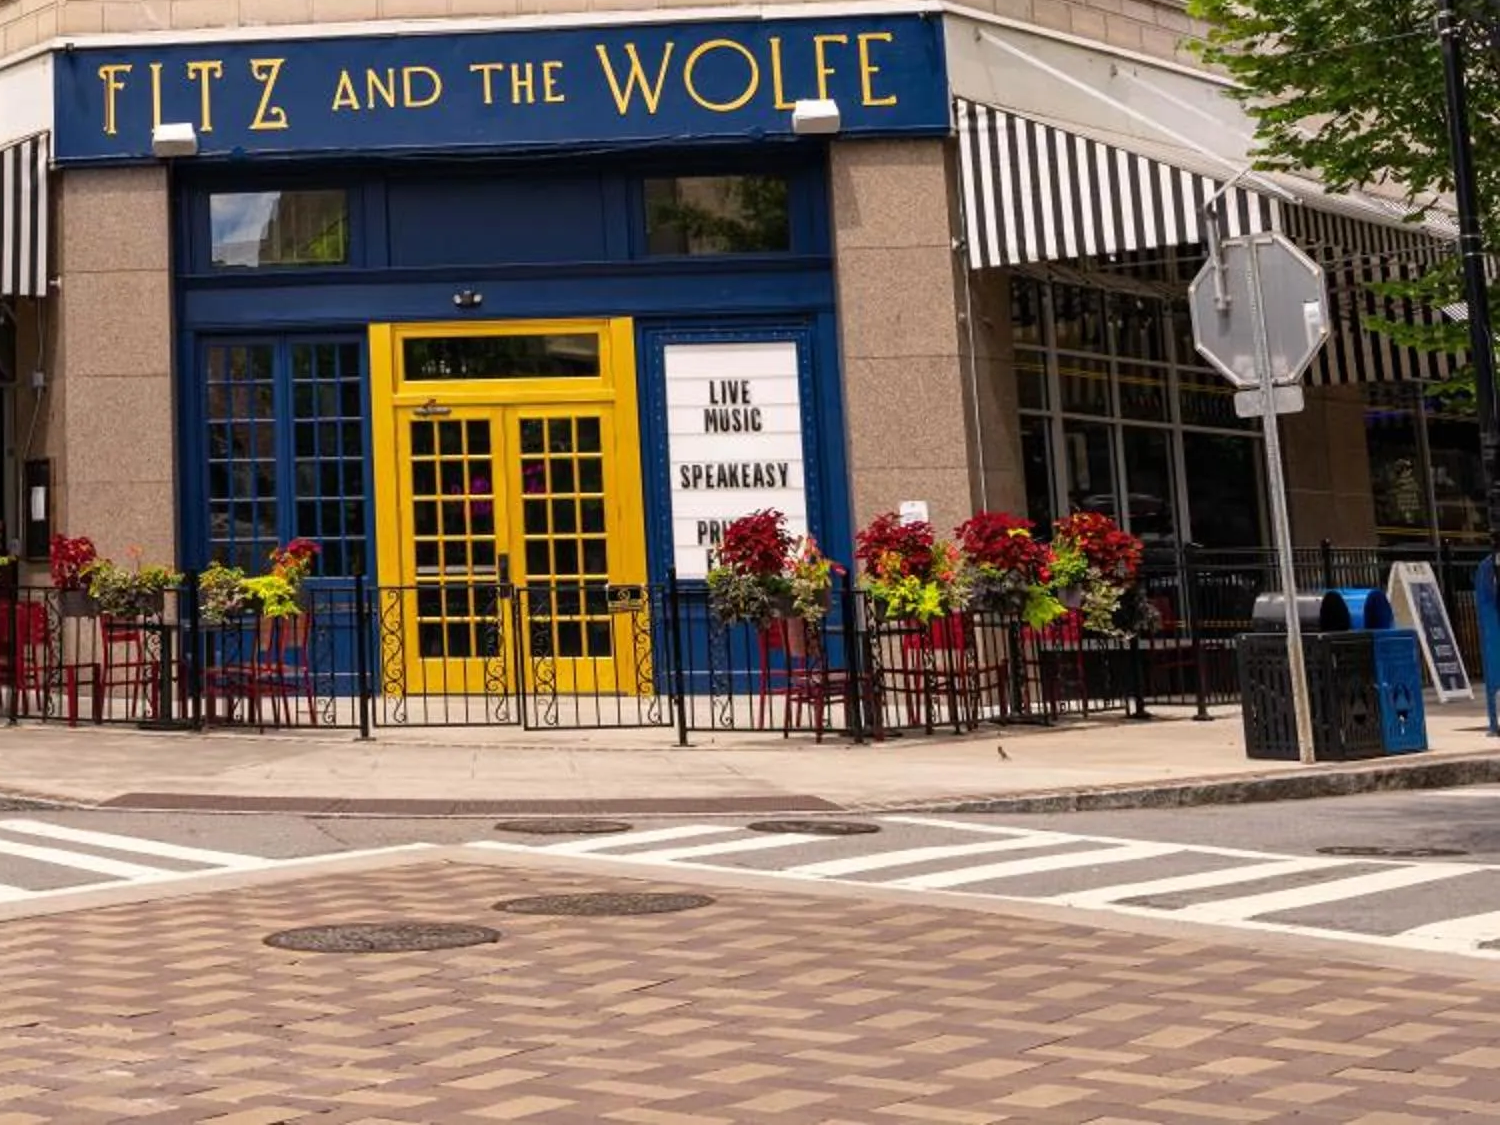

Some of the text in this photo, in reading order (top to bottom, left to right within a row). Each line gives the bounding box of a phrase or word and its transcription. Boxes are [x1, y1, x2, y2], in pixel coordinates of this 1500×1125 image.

[98, 32, 897, 135] FITZ AND THE WOLFE
[709, 380, 751, 405] LIVE
[704, 407, 763, 433] MUSIC
[681, 462, 789, 489] SPEAKEASY
